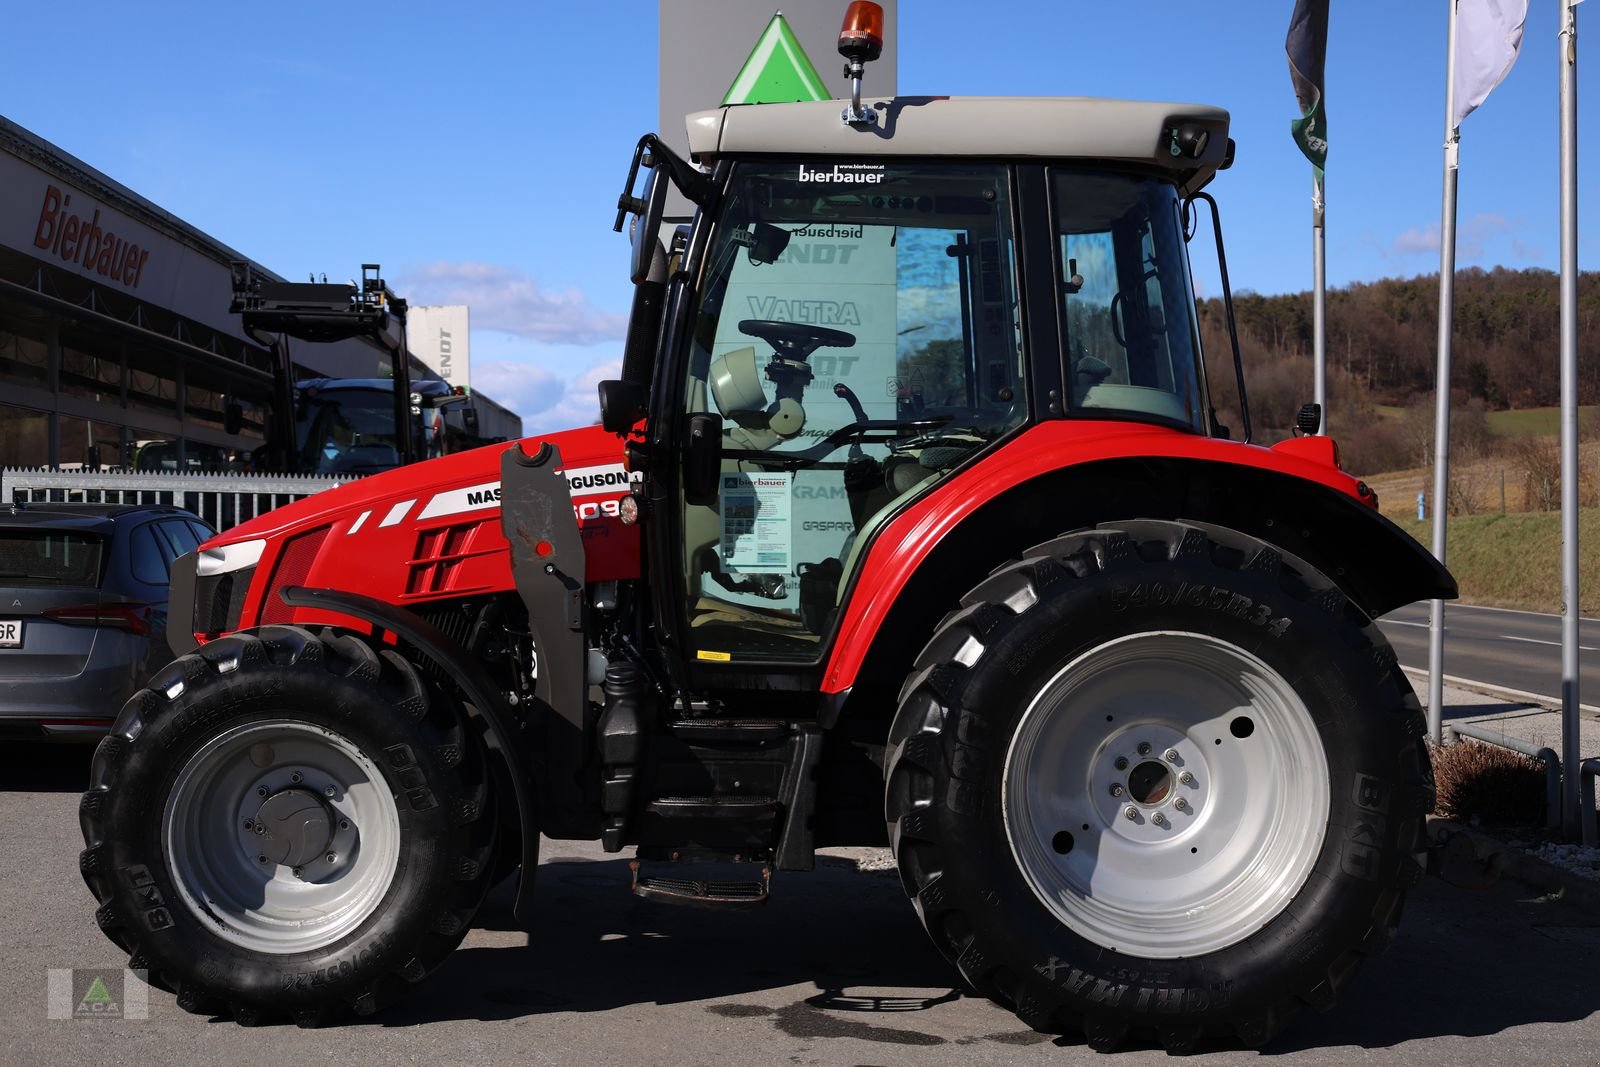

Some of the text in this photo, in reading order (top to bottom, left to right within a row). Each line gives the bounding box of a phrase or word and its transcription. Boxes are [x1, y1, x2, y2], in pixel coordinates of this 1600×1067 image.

[799, 164, 885, 183] bierbauer
[33, 184, 149, 288] Bierbauer
[776, 244, 859, 264] NDT
[747, 296, 861, 325] VALTRA
[440, 328, 452, 378] ENDT
[467, 471, 629, 505] MAS GUSON
[792, 485, 846, 499] KRAM
[574, 500, 620, 520] 09
[802, 521, 853, 532] GASPAR
[1112, 582, 1293, 638] 540/65R34
[131, 864, 174, 930] BKT
